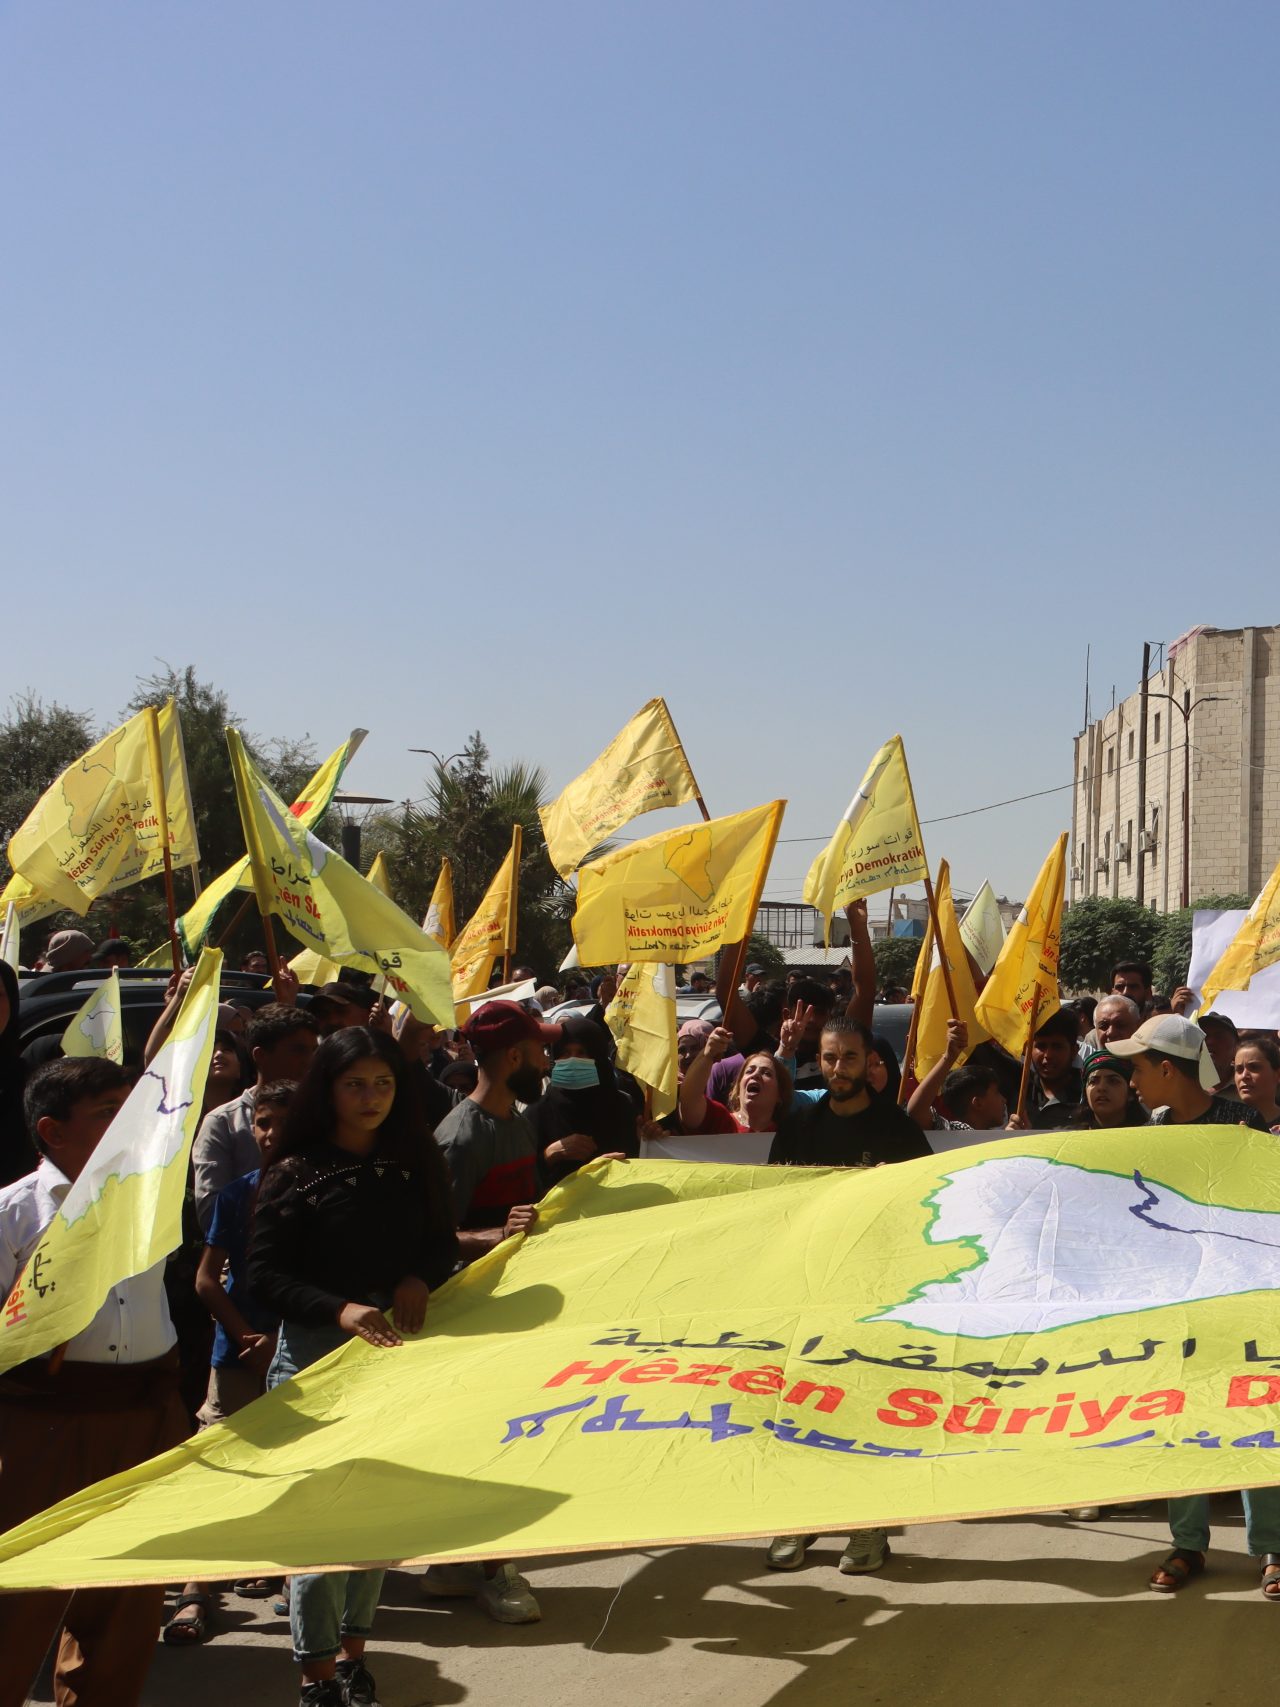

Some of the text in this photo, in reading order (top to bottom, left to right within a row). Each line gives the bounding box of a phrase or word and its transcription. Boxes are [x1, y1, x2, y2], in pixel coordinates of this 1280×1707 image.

[590, 1327, 1197, 1390] الديمقراطية
[542, 1356, 846, 1414] Hêzên
[875, 1388, 1186, 1438] Sûriya
